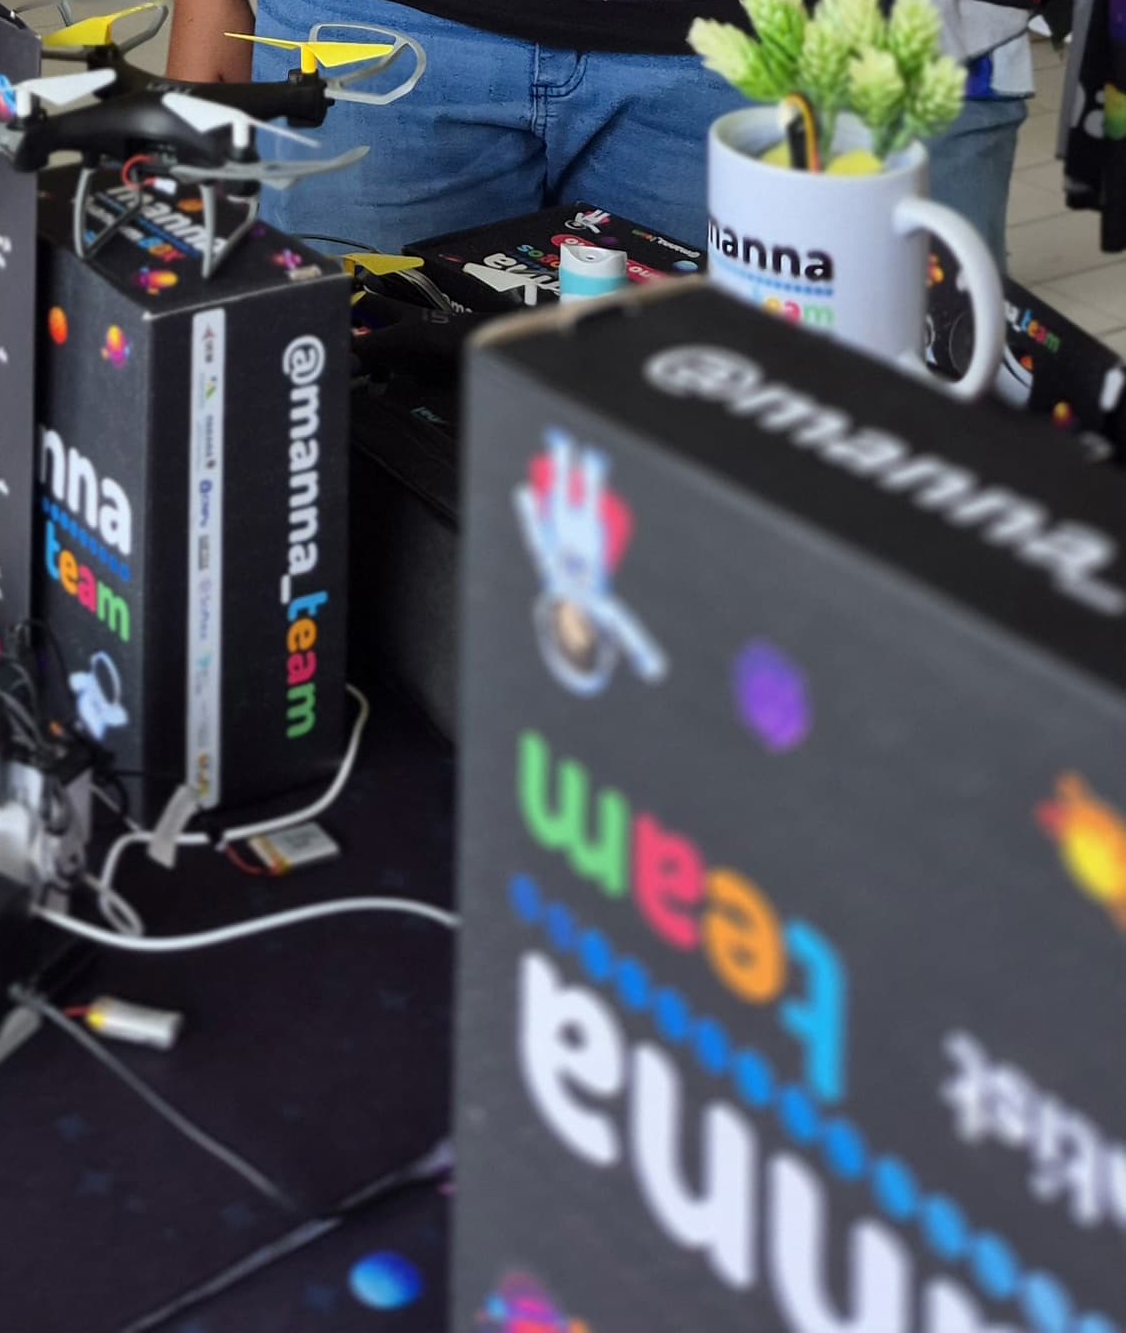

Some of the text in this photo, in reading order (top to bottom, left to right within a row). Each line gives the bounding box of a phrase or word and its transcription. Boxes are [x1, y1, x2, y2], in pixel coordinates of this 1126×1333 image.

[45, 520, 131, 643] team
[281, 335, 329, 739] @manna_team
[517, 730, 847, 1101] team
